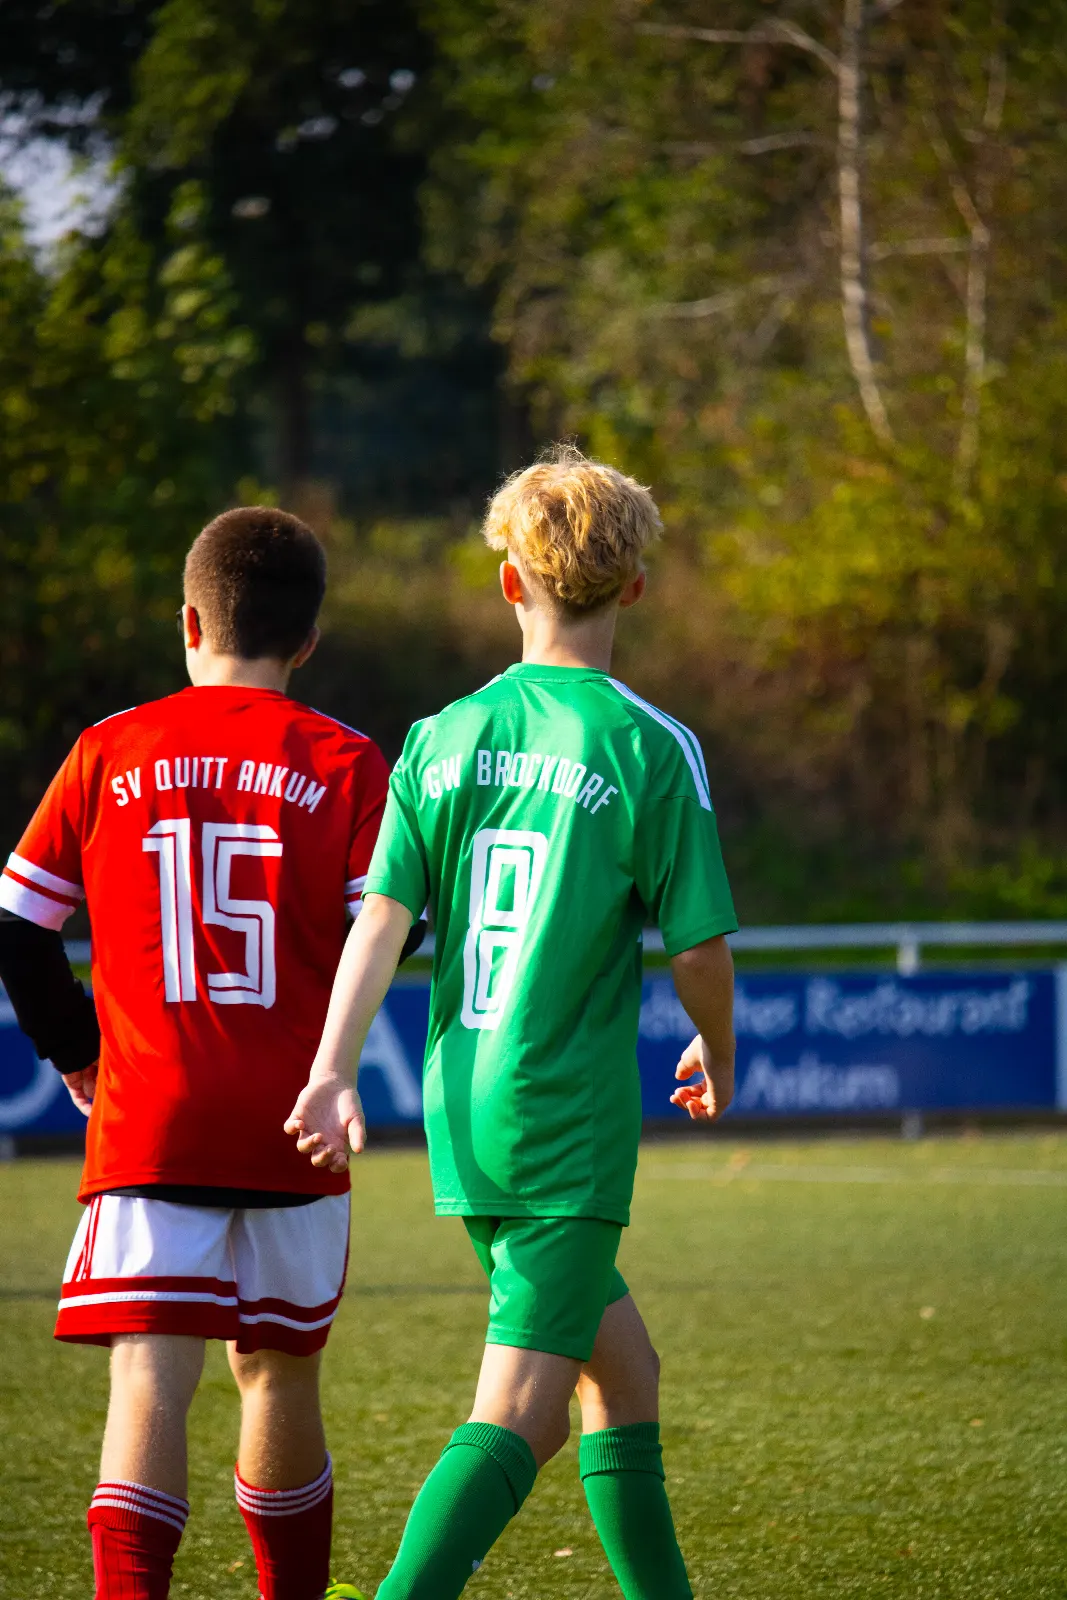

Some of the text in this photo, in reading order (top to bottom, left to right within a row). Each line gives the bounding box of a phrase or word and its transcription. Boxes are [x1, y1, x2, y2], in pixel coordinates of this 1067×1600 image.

[111, 756, 327, 814] SV QUITT ANKUM
[426, 749, 619, 815] GW BROCKDORF
[141, 817, 284, 1010] 15
[460, 827, 549, 1031] 8
